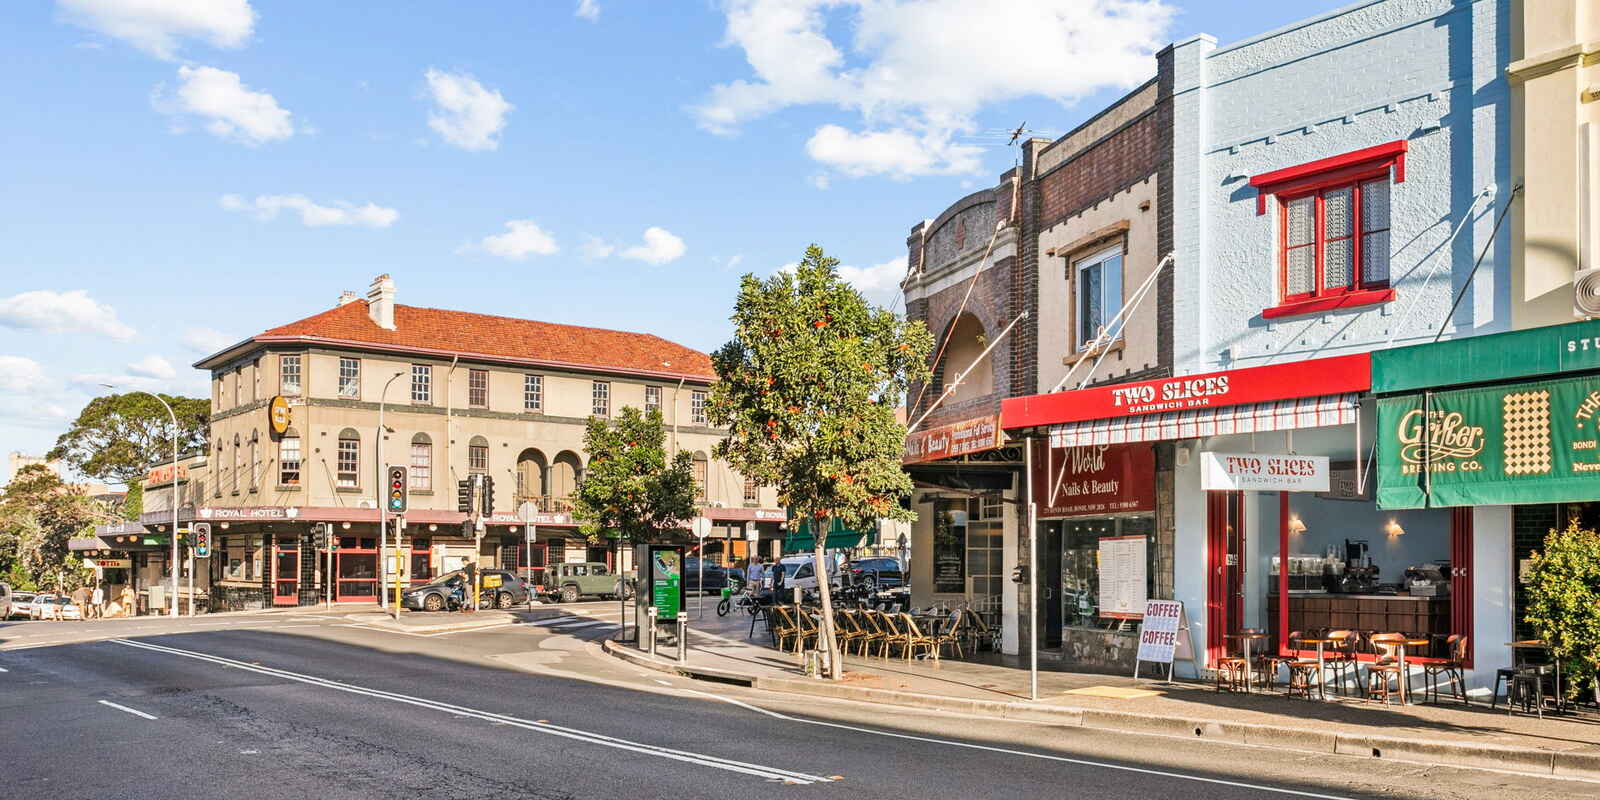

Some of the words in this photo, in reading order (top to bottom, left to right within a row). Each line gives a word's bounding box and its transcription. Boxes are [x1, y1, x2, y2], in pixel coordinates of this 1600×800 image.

[1112, 385, 1156, 406] TWO
[1162, 376, 1230, 400] SLICES
[1129, 402, 1183, 413] SANDWICH
[1187, 398, 1209, 407] BAR
[1573, 440, 1597, 449] BONDI
[1072, 444, 1109, 475] World
[1227, 457, 1261, 474] TWO
[1267, 459, 1315, 476] SLICES
[1461, 461, 1483, 471] CO.
[1062, 481, 1081, 496] Nails
[1082, 480, 1090, 495] &
[1091, 479, 1119, 495] Beauty
[215, 509, 246, 518] ROYAL
[251, 509, 284, 518] HOTEL
[1147, 603, 1179, 617] COFFEE
[1143, 631, 1175, 645] COFFEE
